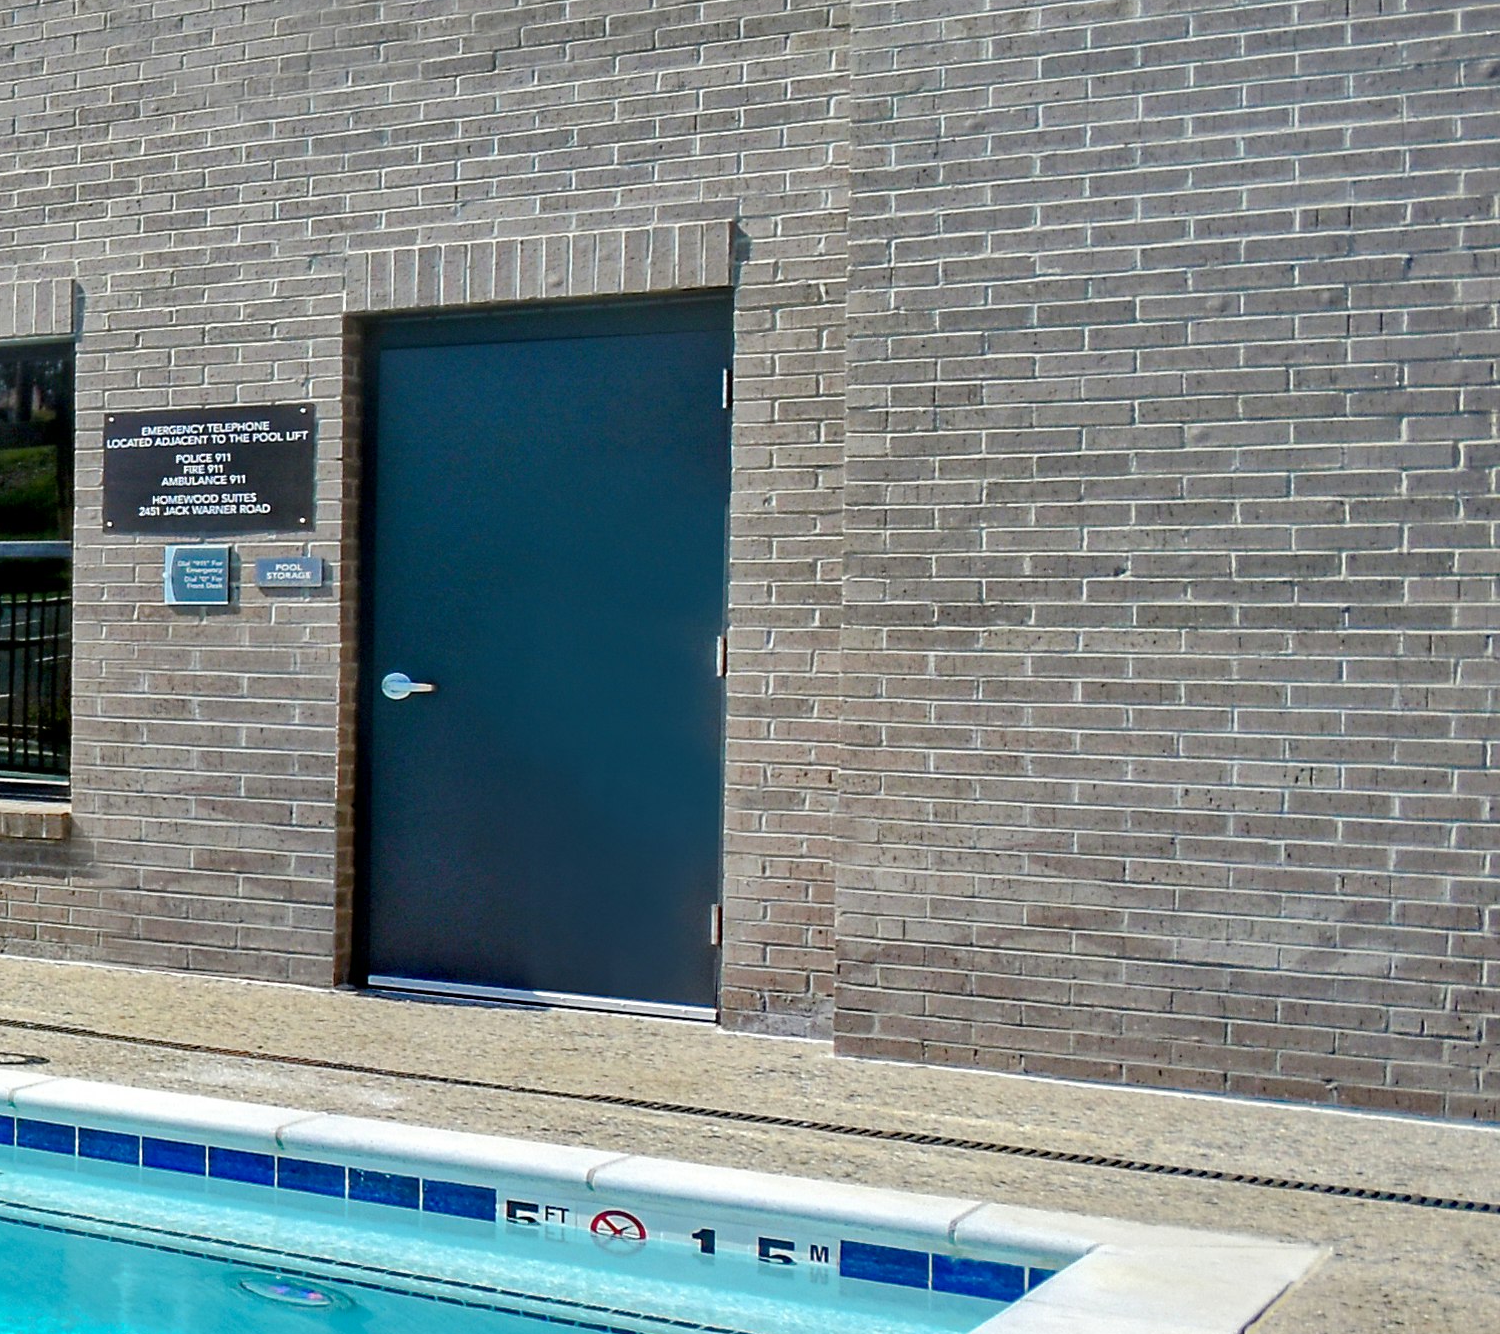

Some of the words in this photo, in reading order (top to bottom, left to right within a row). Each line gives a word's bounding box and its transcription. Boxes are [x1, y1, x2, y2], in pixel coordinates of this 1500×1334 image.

[141, 424, 205, 436] EMERGENCY
[207, 421, 270, 433] TELEPHONE
[107, 437, 152, 449] LOCATED
[154, 435, 208, 447] ADJACENT
[211, 434, 226, 445] TO
[230, 433, 249, 443] THE
[252, 432, 283, 442] POOL
[286, 430, 309, 441] LIFT
[175, 454, 213, 464] POLICE
[215, 452, 231, 462] 911
[183, 465, 205, 475] FIRE
[207, 464, 224, 473] 911
[161, 475, 227, 486] AMBULANCE
[229, 474, 246, 484] 911
[152, 494, 219, 505] HOMEWOOD
[221, 492, 257, 503] SUITES
[139, 507, 160, 517] 2451
[163, 506, 190, 516] JACK
[192, 504, 237, 515] WARNER
[239, 503, 271, 514] ROAD
[275, 563, 303, 571] POOL
[266, 571, 312, 580] STORAGE
[545, 1205, 570, 1224] FT
[810, 1243, 830, 1264] M
